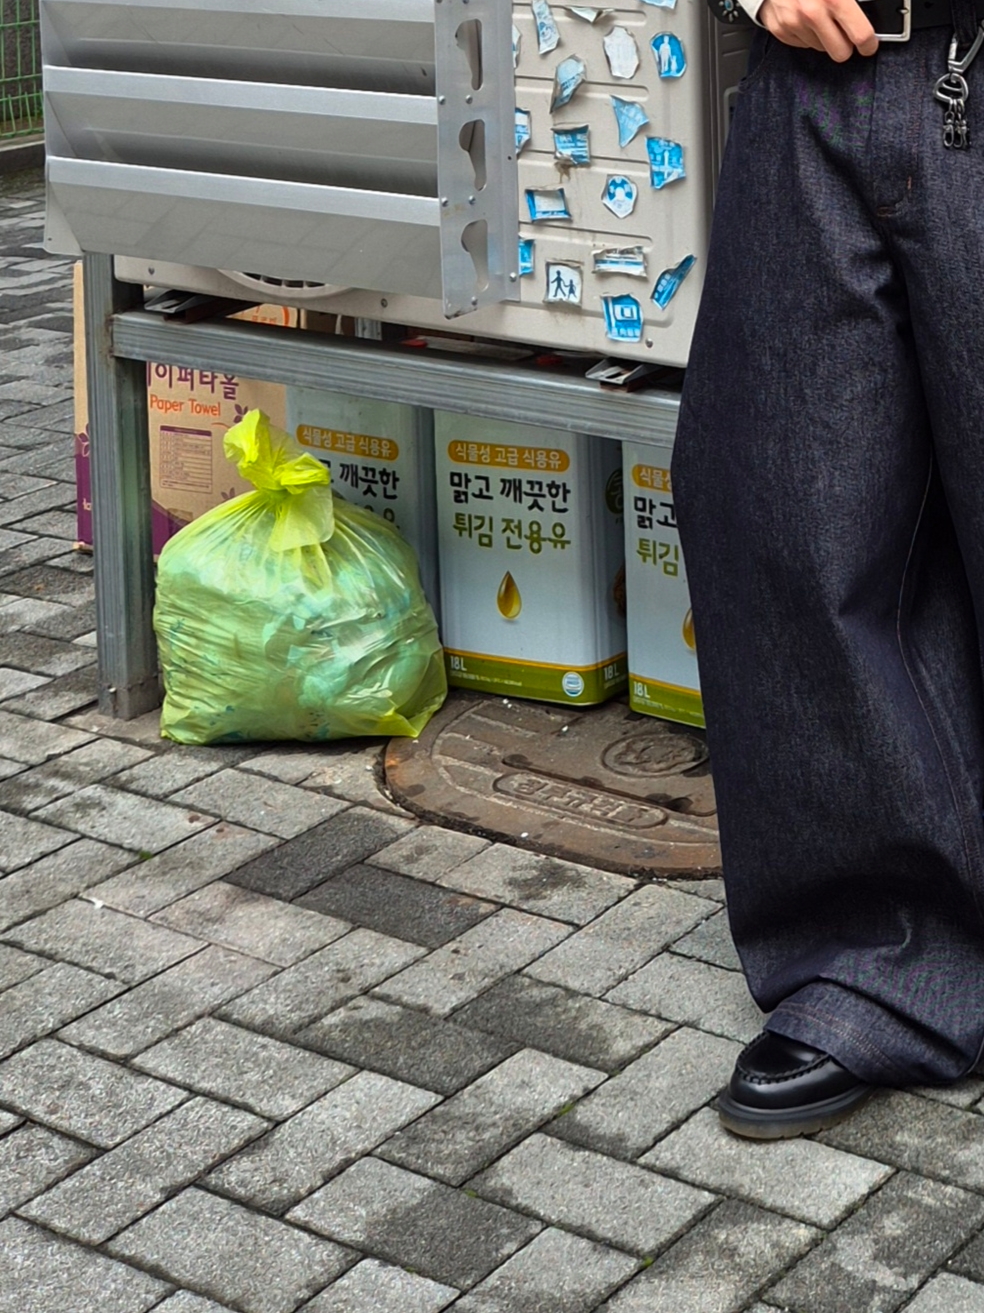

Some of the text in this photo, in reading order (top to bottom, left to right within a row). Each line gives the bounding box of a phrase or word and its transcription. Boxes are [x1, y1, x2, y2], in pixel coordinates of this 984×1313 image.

[150, 394, 221, 417] Paper Towel
[302, 427, 392, 458] 식물성 고급 식용유
[455, 443, 562, 470] 식물성 고급 식용유
[339, 462, 400, 501] 깨끗한
[449, 471, 494, 505] 맑고
[499, 477, 571, 514] 깨끗한
[633, 495, 677, 530] 맑고
[452, 512, 571, 555] 튀김 전용유
[636, 537, 680, 578] 튀김
[450, 655, 468, 672] 18L
[633, 680, 651, 699] 18L
